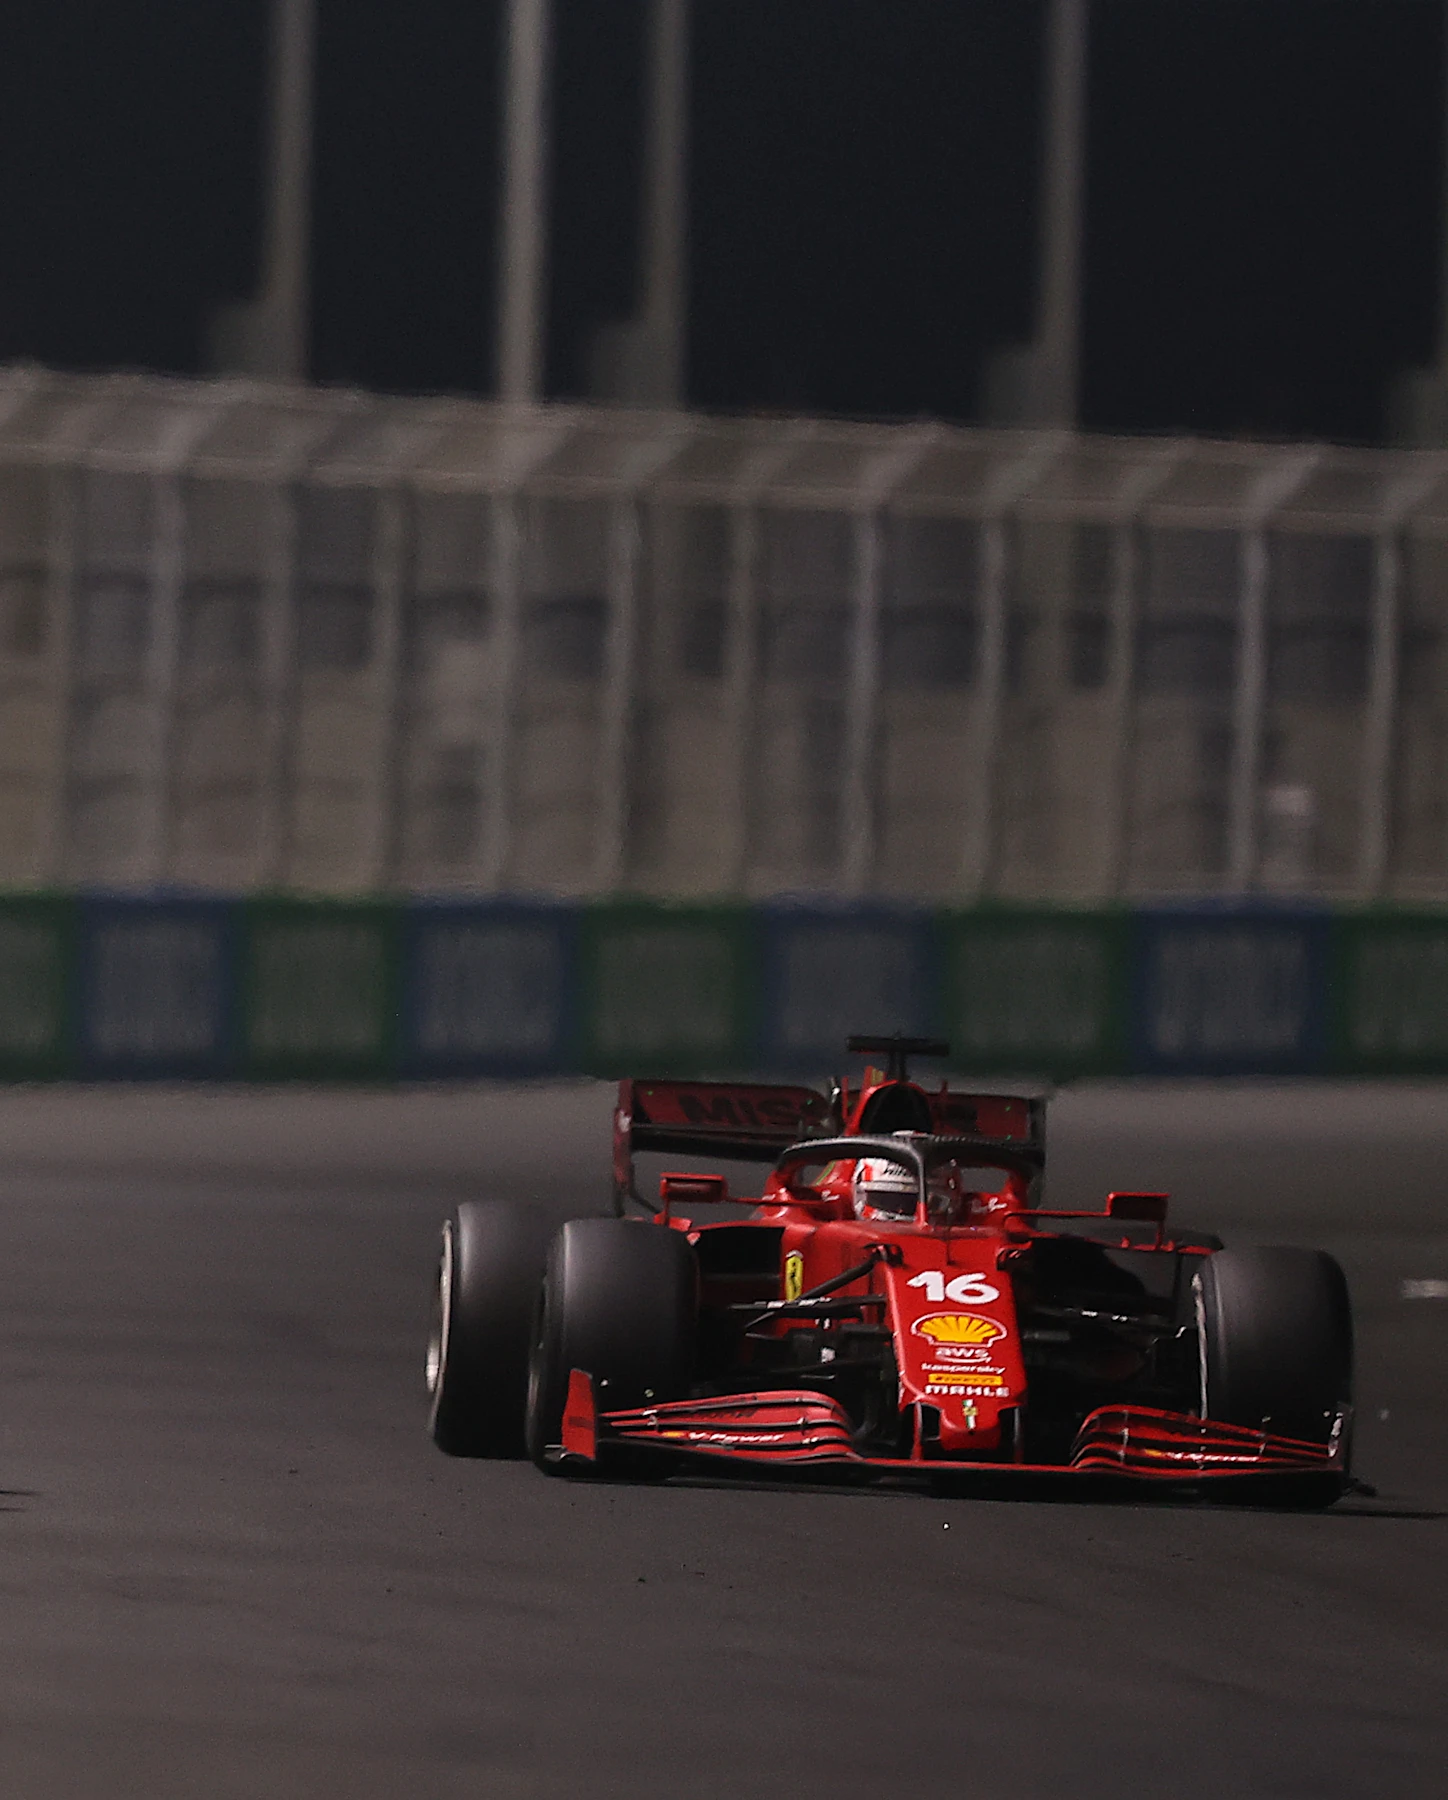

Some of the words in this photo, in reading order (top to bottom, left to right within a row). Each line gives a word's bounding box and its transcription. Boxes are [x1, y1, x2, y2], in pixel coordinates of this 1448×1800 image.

[906, 1270, 1000, 1304] 16
[935, 1346, 990, 1358] aws
[925, 1384, 1010, 1398] MAHLE
